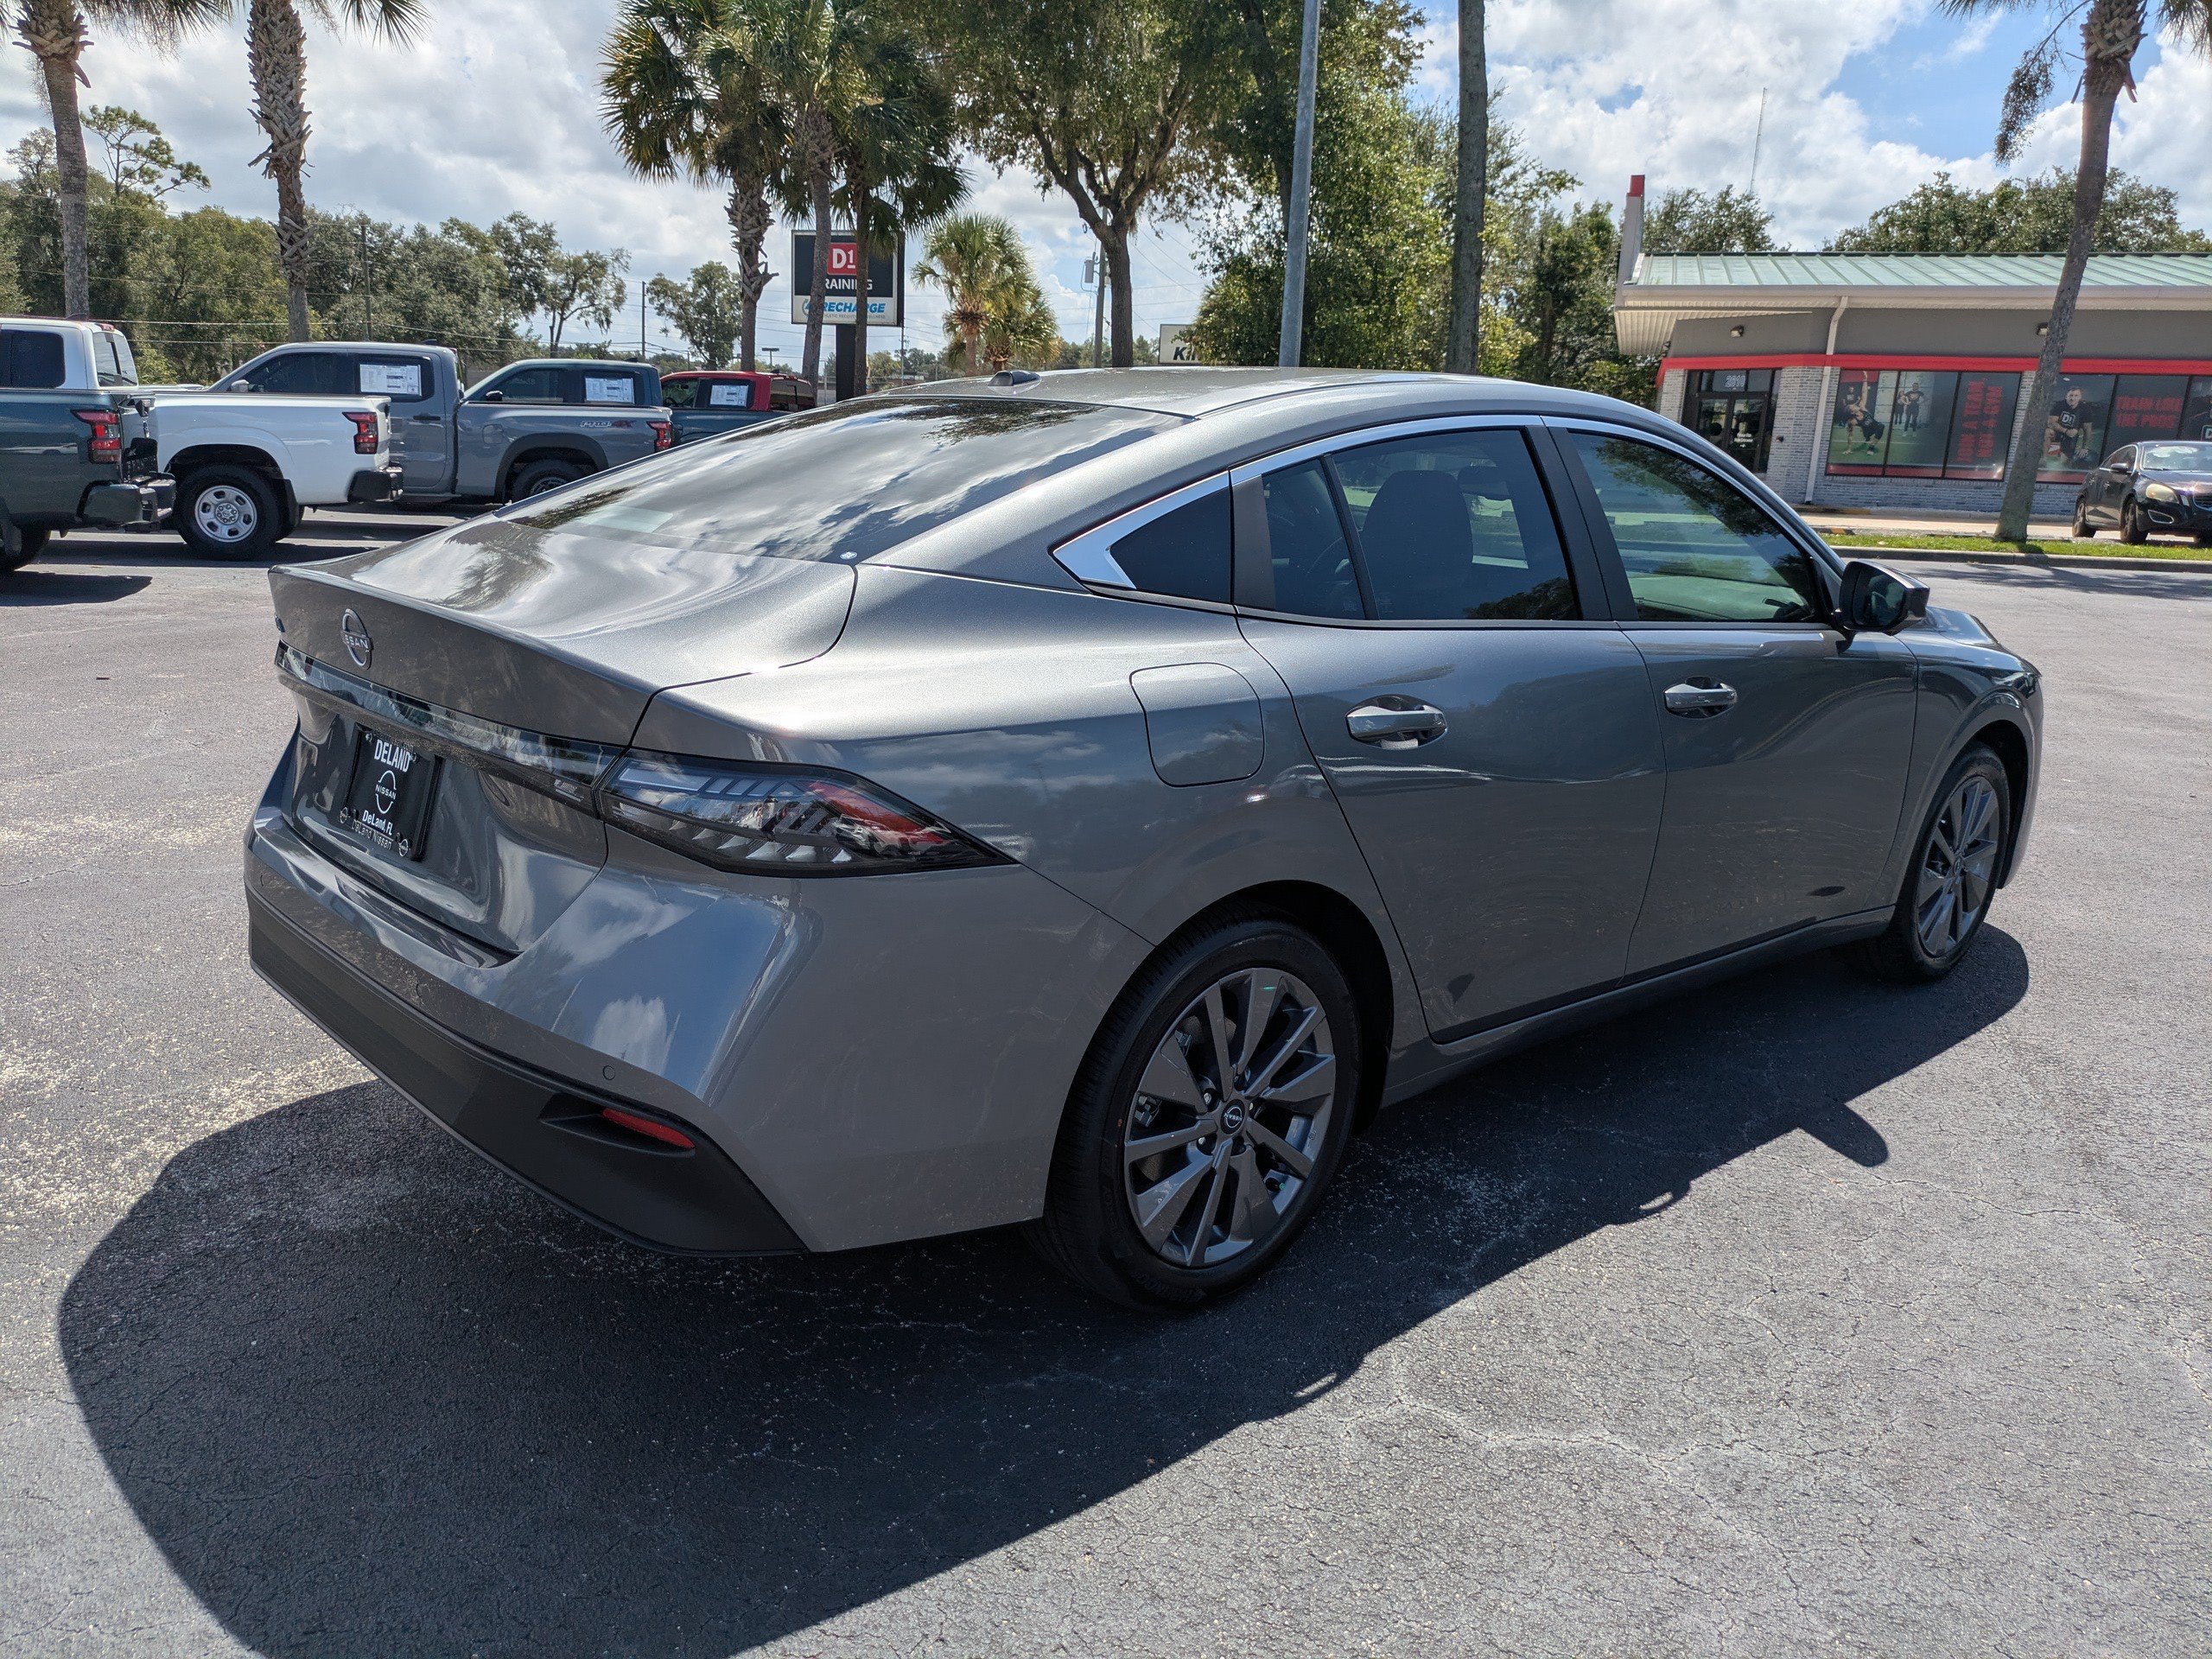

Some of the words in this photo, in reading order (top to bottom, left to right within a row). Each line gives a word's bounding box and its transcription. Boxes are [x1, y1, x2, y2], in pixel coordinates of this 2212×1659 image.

[832, 248, 856, 269] D1
[374, 739, 410, 772] DELAND
[375, 784, 397, 800] NISSAN
[385, 821, 393, 836] FL
